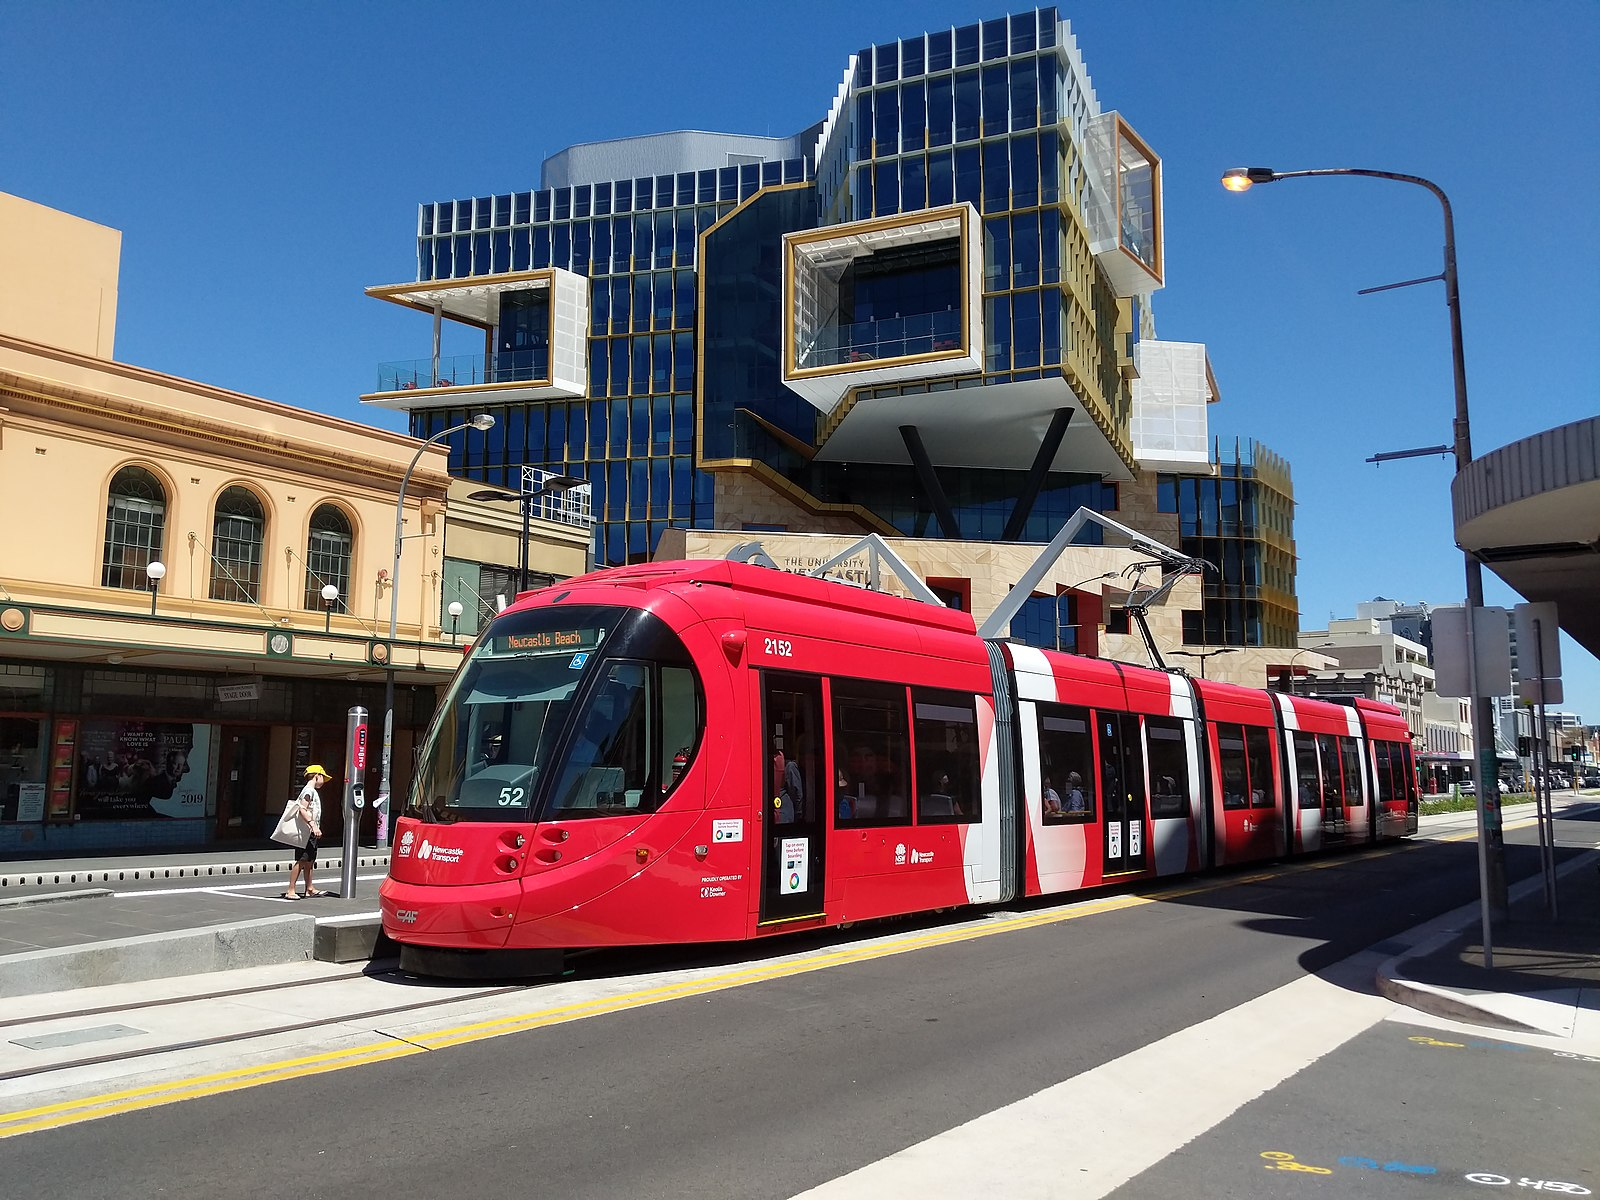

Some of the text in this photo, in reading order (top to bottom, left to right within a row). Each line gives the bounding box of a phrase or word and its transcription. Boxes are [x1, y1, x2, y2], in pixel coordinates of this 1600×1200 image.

[784, 557, 803, 566] THE
[508, 630, 581, 648] Newcastle Beach
[764, 637, 793, 657] 2152
[163, 736, 189, 744] PAUL
[181, 794, 204, 804] 2019
[498, 787, 525, 806] 52
[112, 802, 148, 810] everywhere
[399, 845, 412, 854] NSW
[432, 845, 464, 856] Newcastle
[432, 853, 459, 863] Transport
[396, 909, 419, 924] CAF
